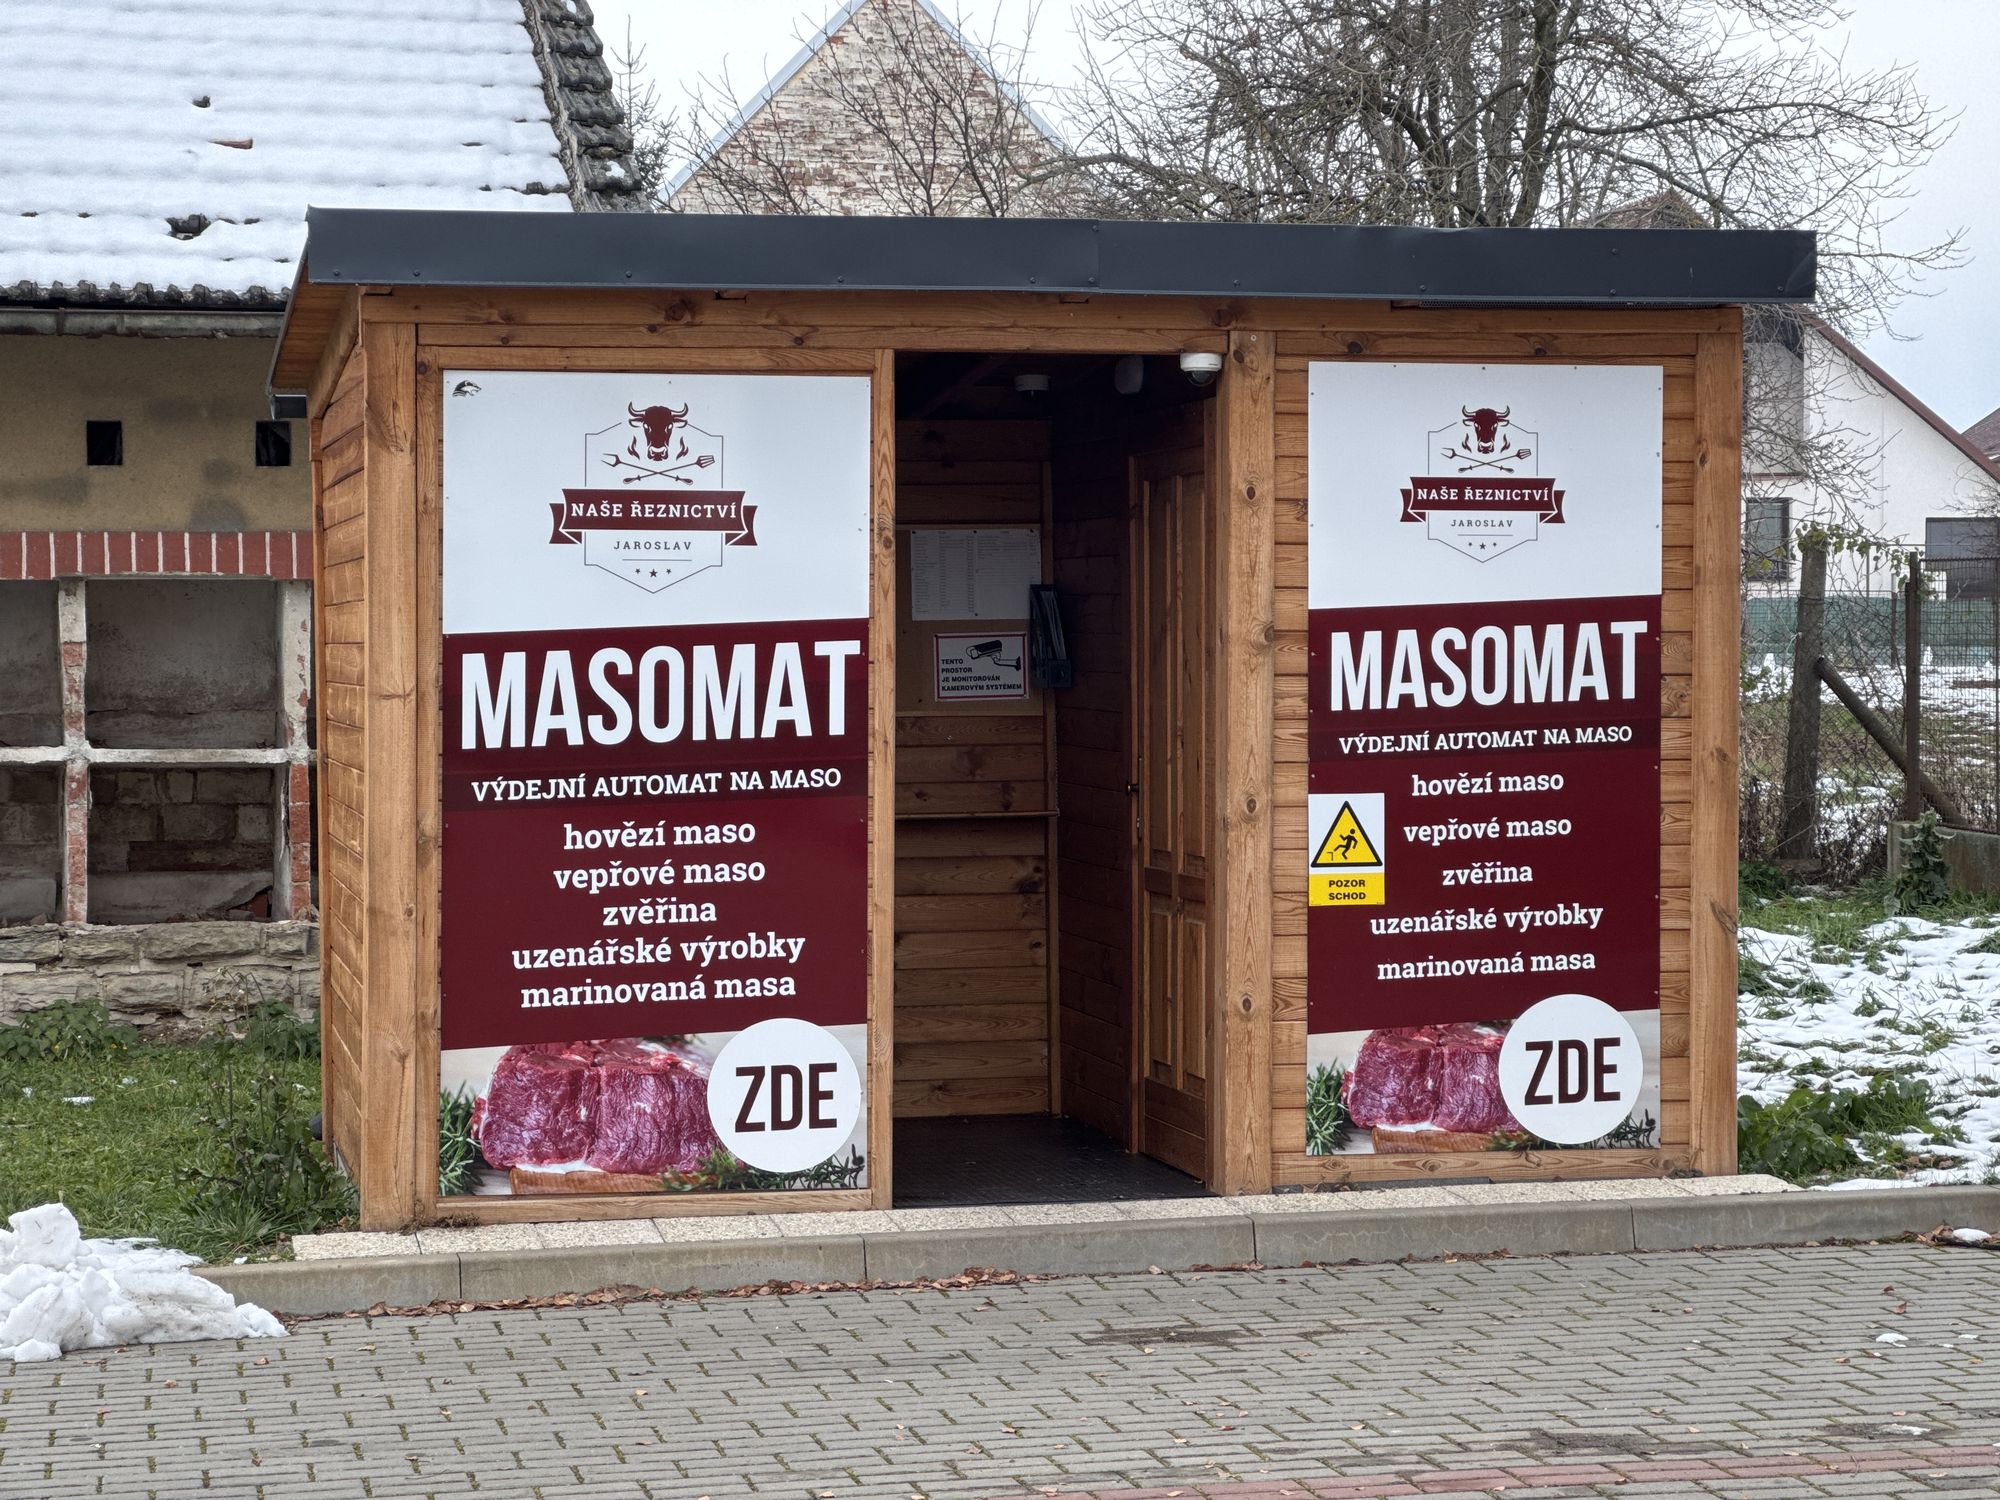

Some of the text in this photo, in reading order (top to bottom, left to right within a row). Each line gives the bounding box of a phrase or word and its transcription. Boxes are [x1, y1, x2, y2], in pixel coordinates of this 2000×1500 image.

[1418, 487, 1548, 500] NAŠE ŘEZNICTVÍ
[572, 501, 736, 518] NAŠE ŘEZNICTVÍ
[1451, 519, 1512, 528] JAROSLAV
[614, 541, 691, 550] JAROSLAV
[1331, 621, 1647, 711] MASOMAT
[462, 640, 860, 749] MASOMAT
[1339, 726, 1632, 753] VÝDEJNÍ AUTOMAT NA MASO
[471, 768, 841, 801] VÝDEJNÍ AUTOMAT NA MASO
[1412, 772, 1563, 796] hovězí maso
[564, 821, 755, 849] hovězí maso
[1404, 817, 1571, 846] vepřové maso
[553, 861, 765, 894] vepřové maso
[1443, 862, 1533, 885] zvěřina
[1329, 892, 1366, 900] SCHOD
[603, 897, 716, 925] zvěřina
[1371, 903, 1603, 934] uzenářské výrobky
[512, 932, 805, 969] uzenářské výrobky
[1378, 952, 1595, 979] marinovaná masa
[521, 977, 796, 1007] marinovaná masa
[1525, 1037, 1620, 1105] ZDE
[735, 1063, 837, 1132] ZDE
